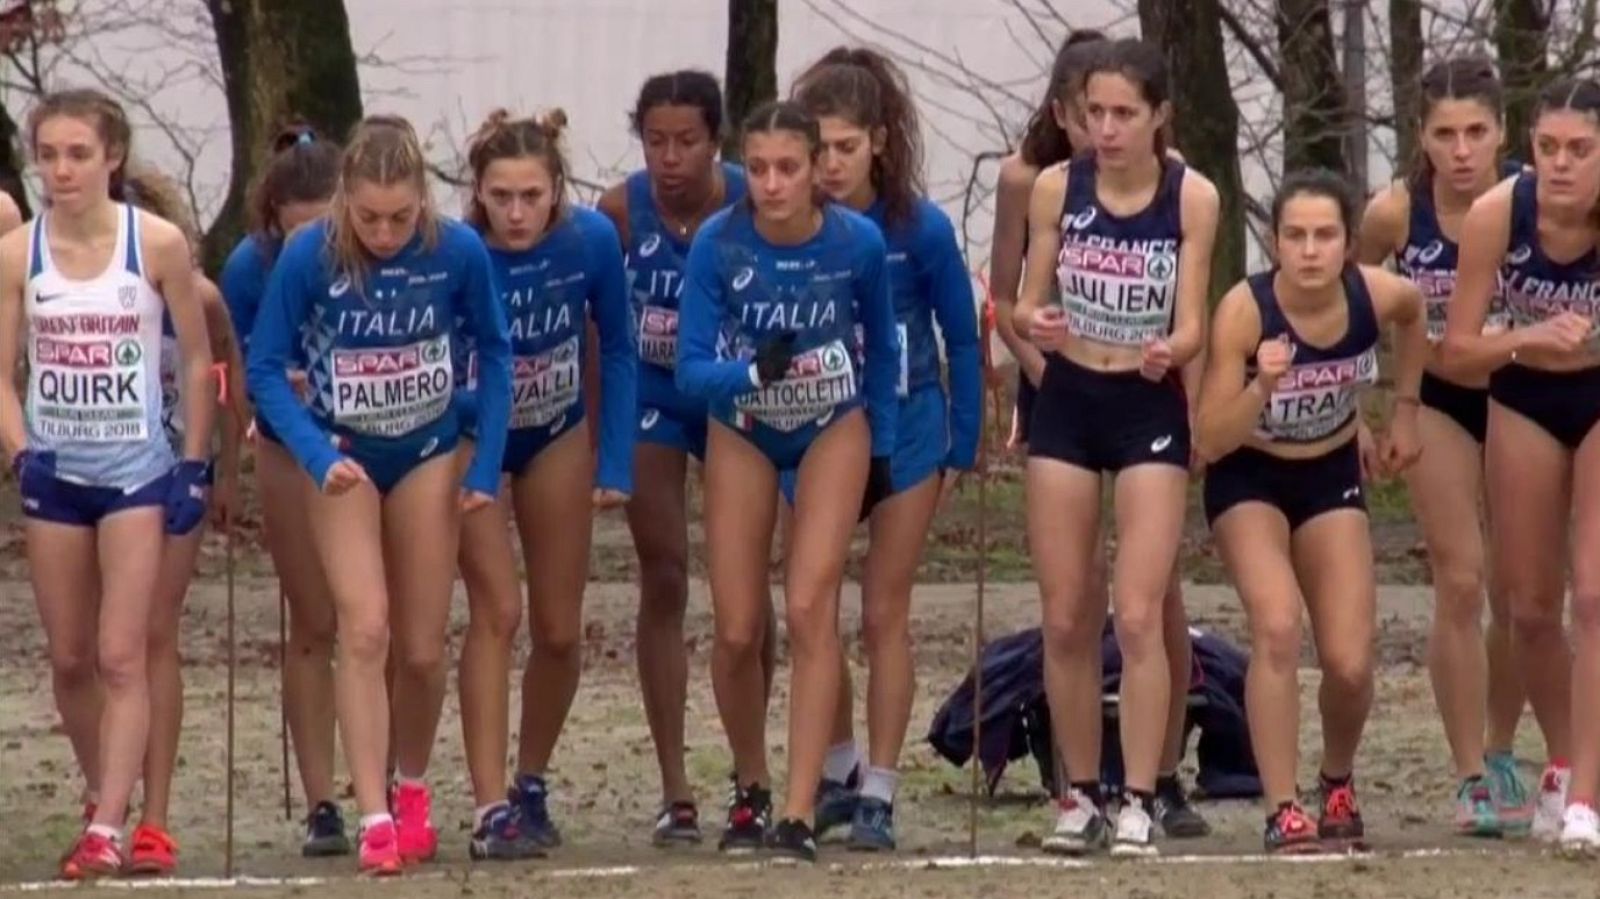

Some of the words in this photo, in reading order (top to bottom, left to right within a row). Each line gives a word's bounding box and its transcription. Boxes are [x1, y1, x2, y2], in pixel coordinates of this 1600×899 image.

[1064, 247, 1143, 276] SPAR
[1065, 274, 1167, 312] JULIEN
[338, 304, 436, 337] ITALIA
[510, 303, 571, 340] ALIA
[742, 300, 836, 330] ITALIA
[38, 341, 111, 365] SPAR
[337, 349, 419, 373] SPAR
[39, 370, 139, 404] QUIRK
[338, 367, 448, 411] PALMERO
[512, 365, 573, 404] VALLI
[1278, 365, 1355, 389] SPAR
